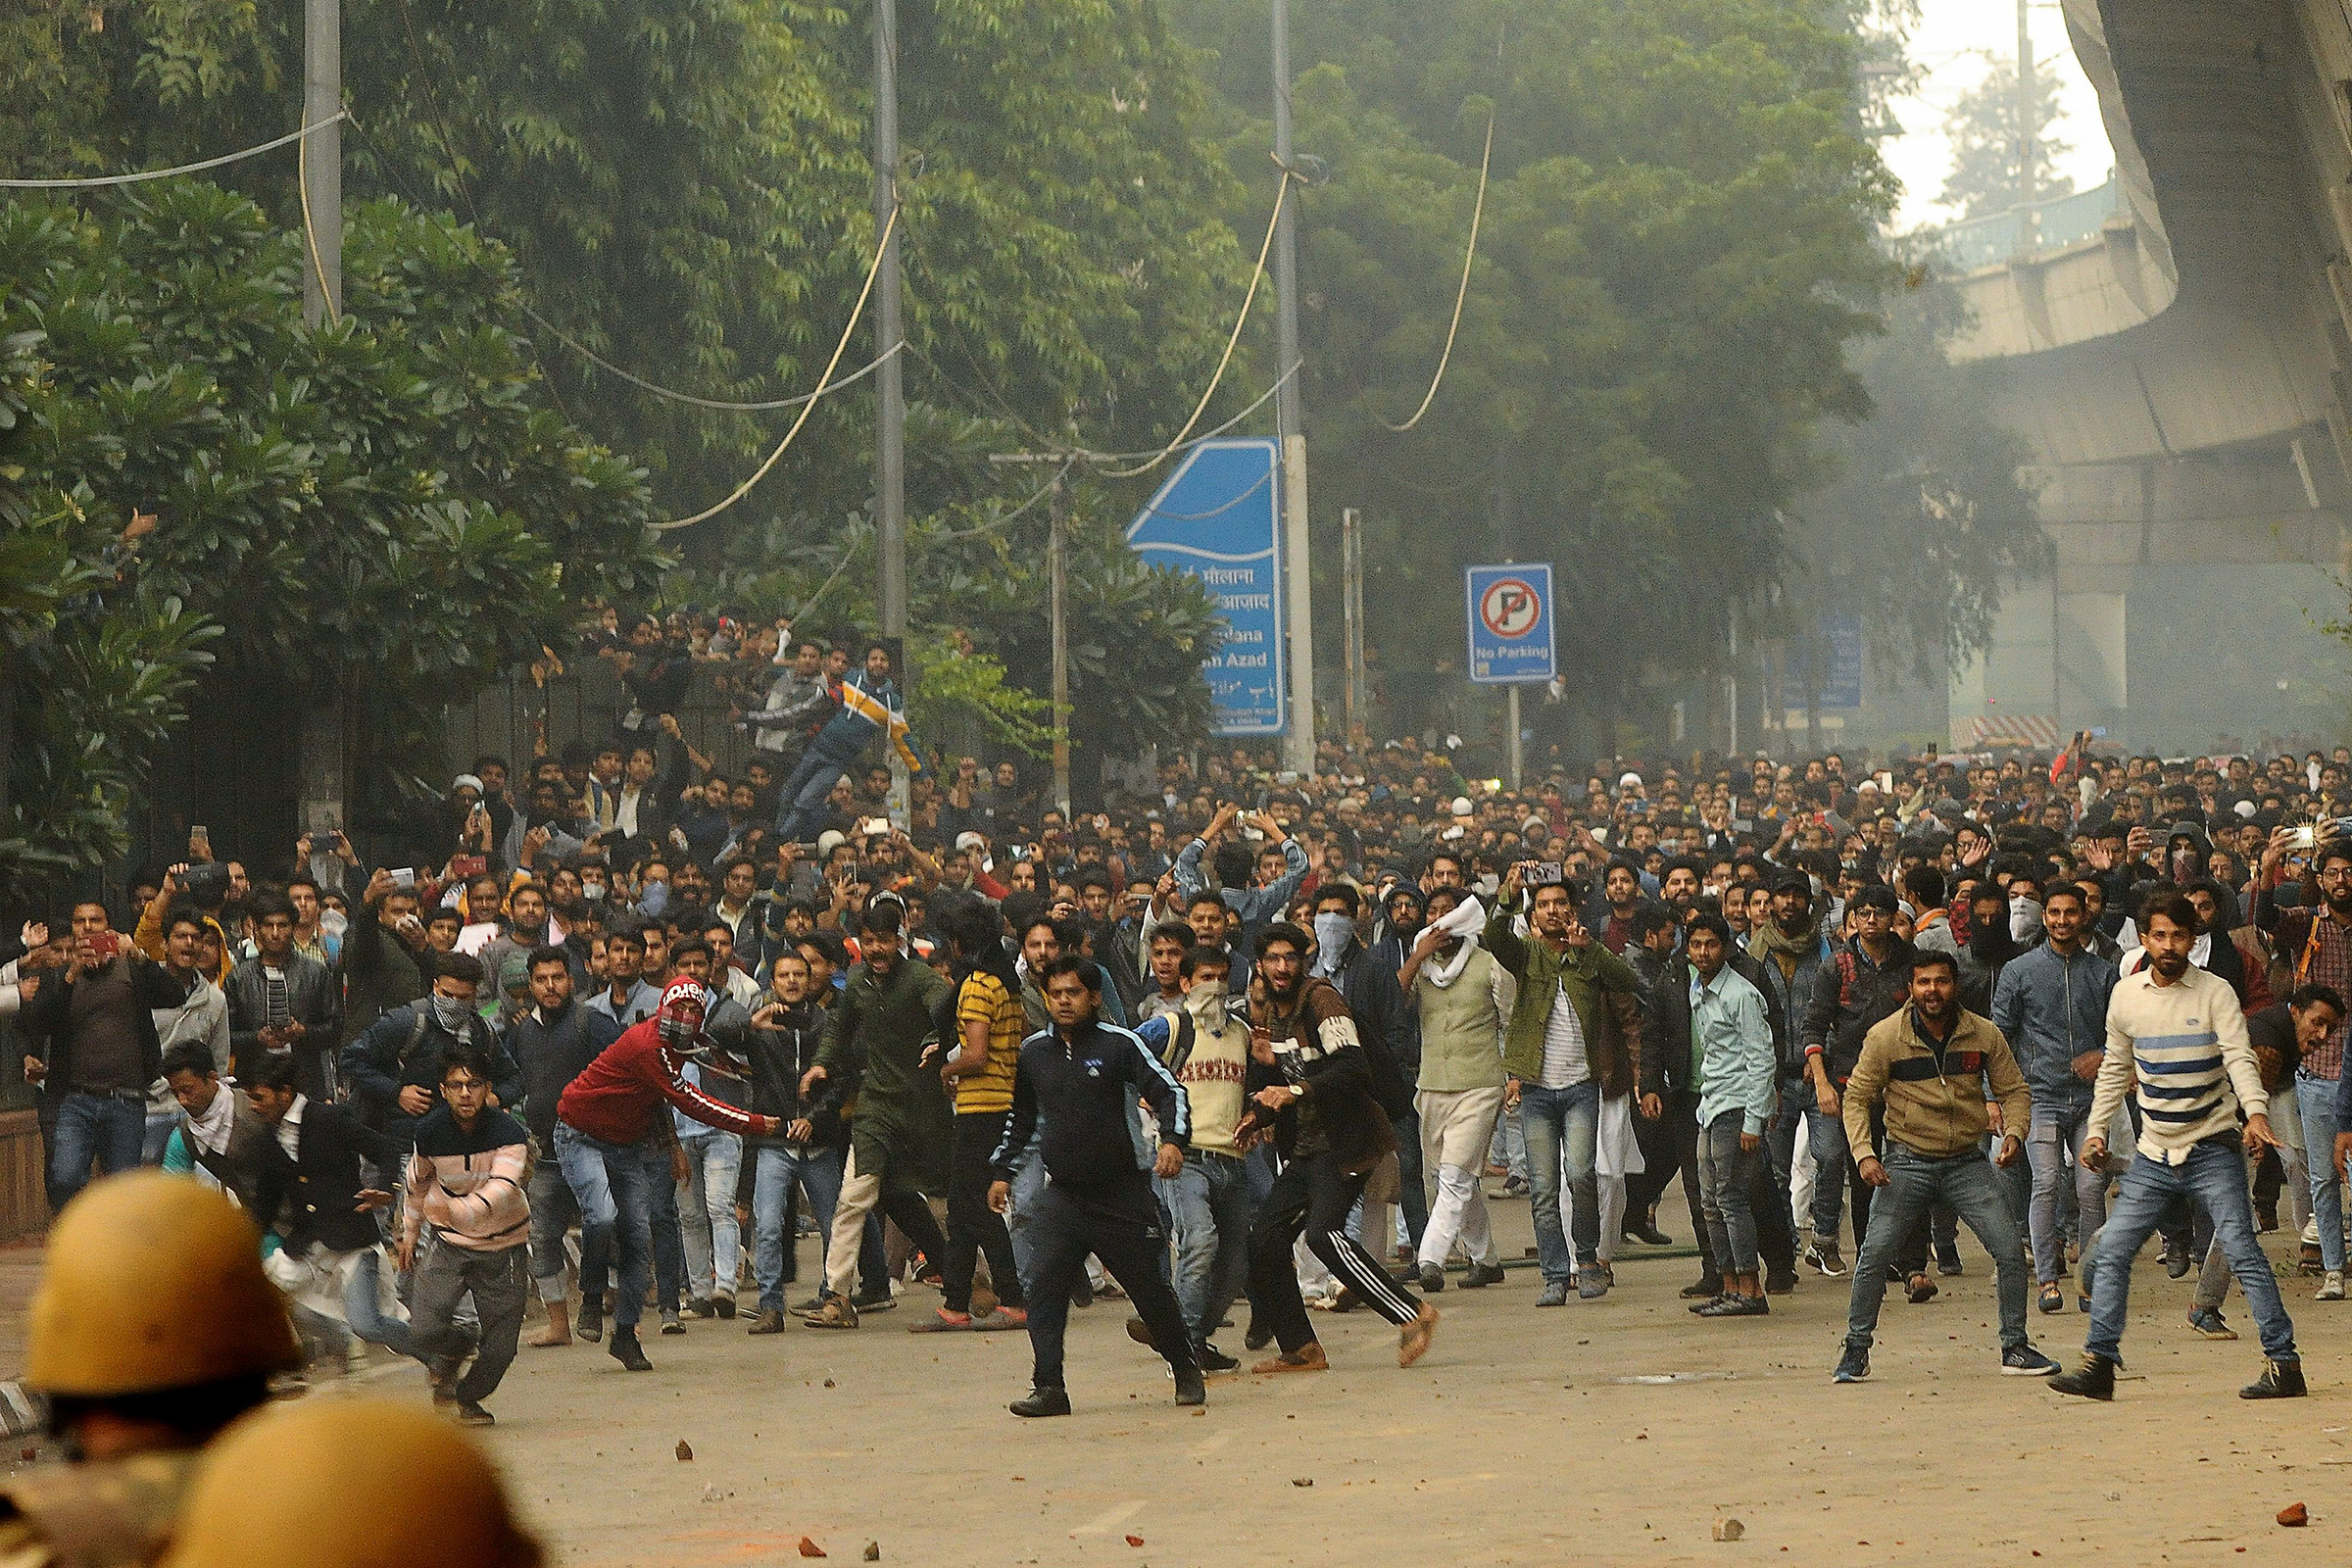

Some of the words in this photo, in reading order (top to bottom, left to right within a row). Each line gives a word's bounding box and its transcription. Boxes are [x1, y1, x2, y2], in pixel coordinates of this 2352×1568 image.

[1226, 651, 1267, 667] Azad
[1476, 647, 1494, 659] No
[1497, 646, 1549, 661] Parking
